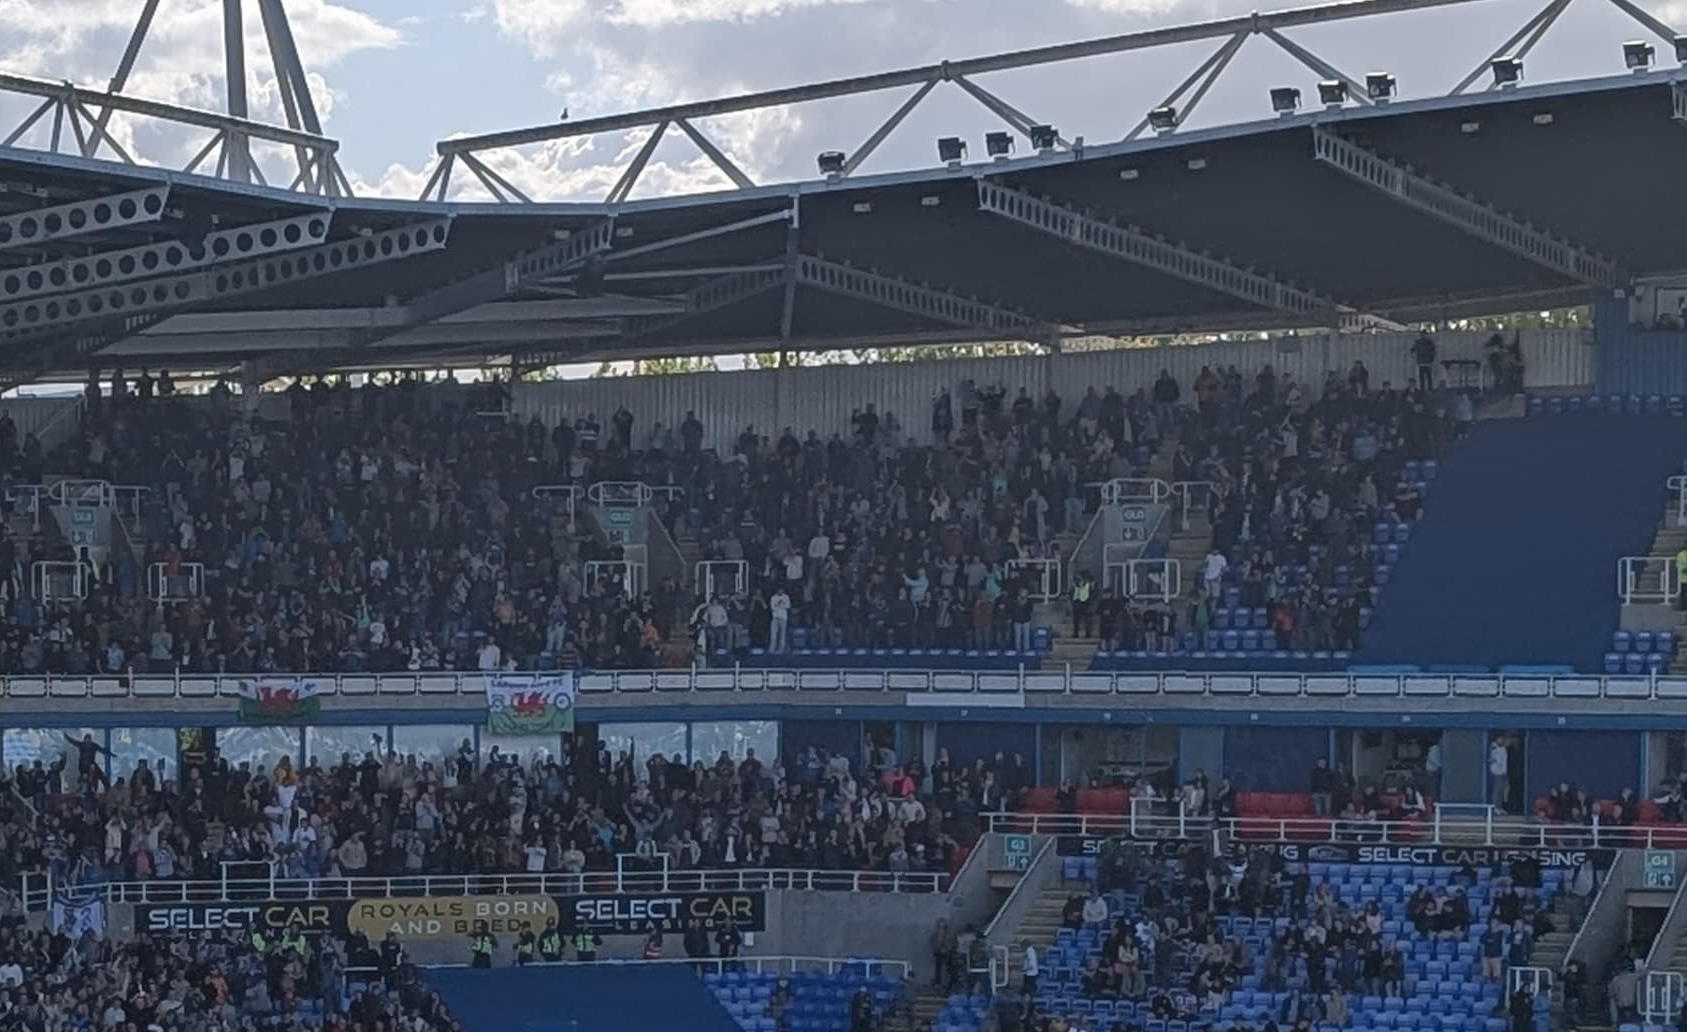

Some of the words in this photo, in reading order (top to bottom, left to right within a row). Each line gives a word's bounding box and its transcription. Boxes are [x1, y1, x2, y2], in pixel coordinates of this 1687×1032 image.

[1357, 846, 1437, 866] SELECT
[148, 907, 260, 929] SELECT
[264, 905, 330, 928] CAR
[360, 902, 464, 918] ROYALS
[475, 900, 548, 916] BORN
[575, 897, 683, 921] SELECT
[689, 895, 753, 918] CAR
[389, 918, 442, 935] AND
